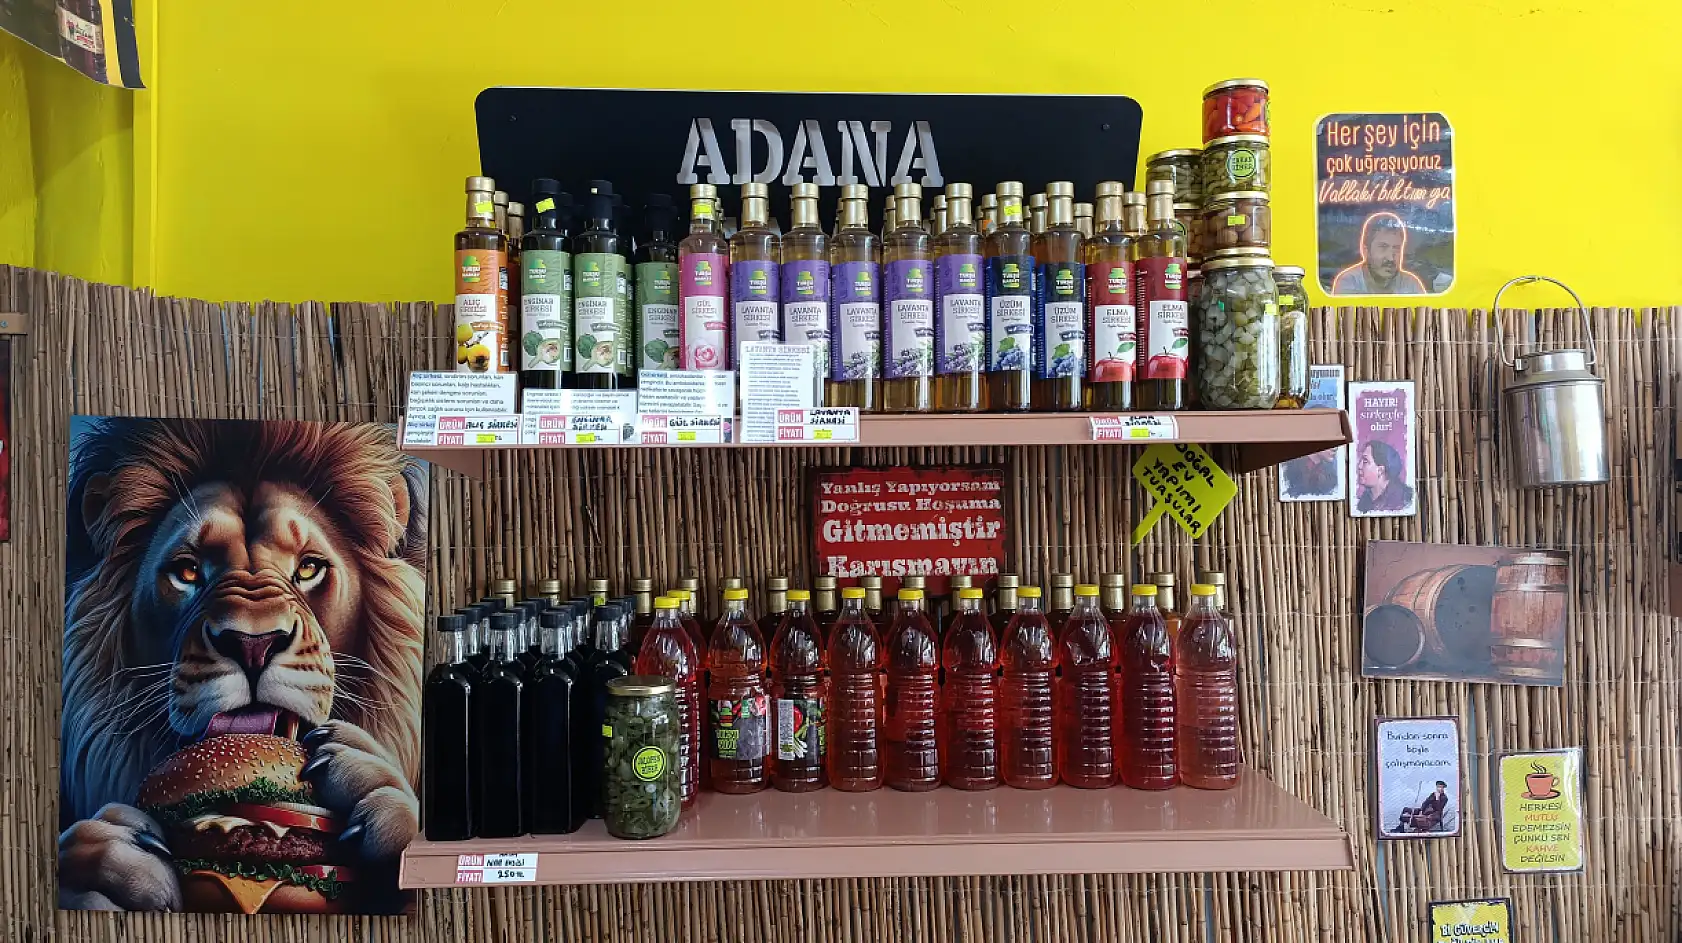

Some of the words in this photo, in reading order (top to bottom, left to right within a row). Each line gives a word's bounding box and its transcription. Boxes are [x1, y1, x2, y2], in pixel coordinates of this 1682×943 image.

[1327, 121, 1361, 147] Her
[1364, 123, 1398, 152] şey
[676, 117, 944, 188] ADANA
[1326, 153, 1353, 180] çok
[1355, 152, 1442, 177] uğraşıyoruz
[1106, 308, 1128, 316] ELMA
[1364, 397, 1398, 408] HAYIR!
[440, 417, 463, 430] ÜRÜN
[541, 417, 564, 429] ÜRÜN
[669, 416, 689, 427] GÜL
[779, 427, 803, 438] FİYATI
[1098, 428, 1122, 438] FİYATI
[438, 433, 463, 445] FİYATI
[540, 433, 565, 444] FİYATI
[643, 433, 667, 444] FİYATI
[1172, 461, 1195, 481] EV
[821, 482, 881, 496] Yanlış
[885, 480, 1001, 496] Yapıyorsam
[1153, 457, 1202, 513] YAPIMI
[821, 498, 911, 516] Doğrusu
[915, 497, 1002, 514] Hoşuma
[823, 515, 1001, 547] Gitmemiştir
[1387, 730, 1420, 741] Bundan
[1422, 732, 1449, 740] sonra
[1406, 744, 1429, 755] böyle
[1519, 801, 1562, 812] HERKESİ
[1524, 813, 1559, 822] MUTLU
[1512, 822, 1571, 833] EDEMEZSİN
[1550, 833, 1570, 842] SEN
[1526, 844, 1559, 853] KAHVE
[1520, 853, 1566, 863] DEĞİLSİN
[457, 872, 482, 882] FİYATI
[497, 870, 515, 879] 250
